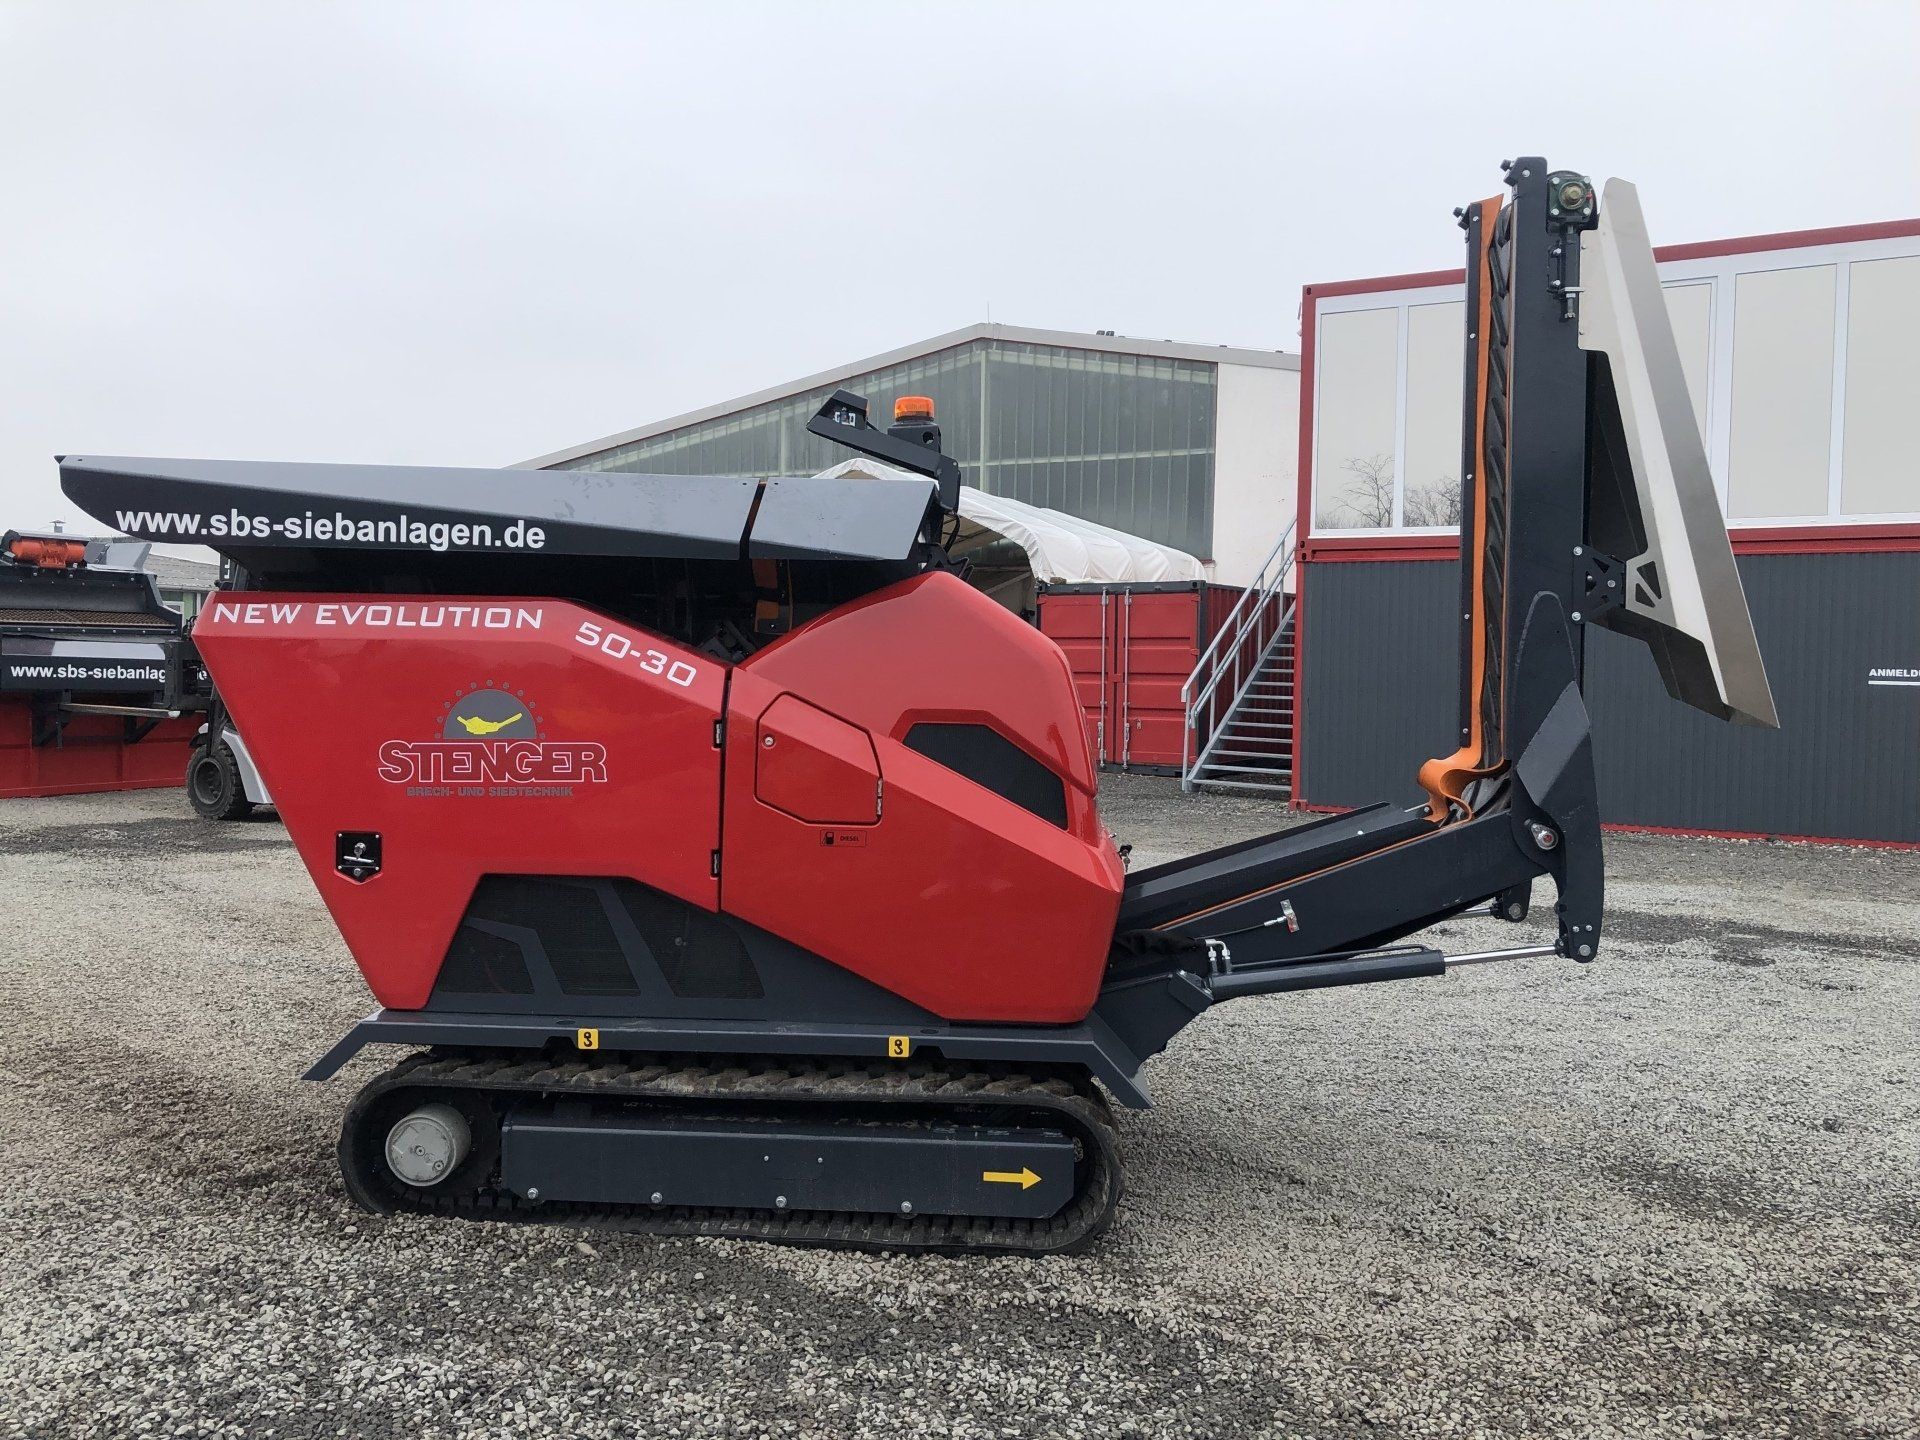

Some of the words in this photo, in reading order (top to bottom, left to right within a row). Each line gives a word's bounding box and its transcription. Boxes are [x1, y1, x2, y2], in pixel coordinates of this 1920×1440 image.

[115, 508, 546, 551] www.sbs-siebanlagen.de
[213, 603, 303, 624] NEW
[315, 605, 543, 629] EVOLUTION
[574, 620, 697, 687] 50-30
[1868, 668, 1920, 677] ANMELD
[378, 740, 608, 783] STENGER
[406, 786, 454, 797] BRECH-
[457, 786, 485, 797] UND
[488, 786, 574, 798] SIEBTECHNIK
